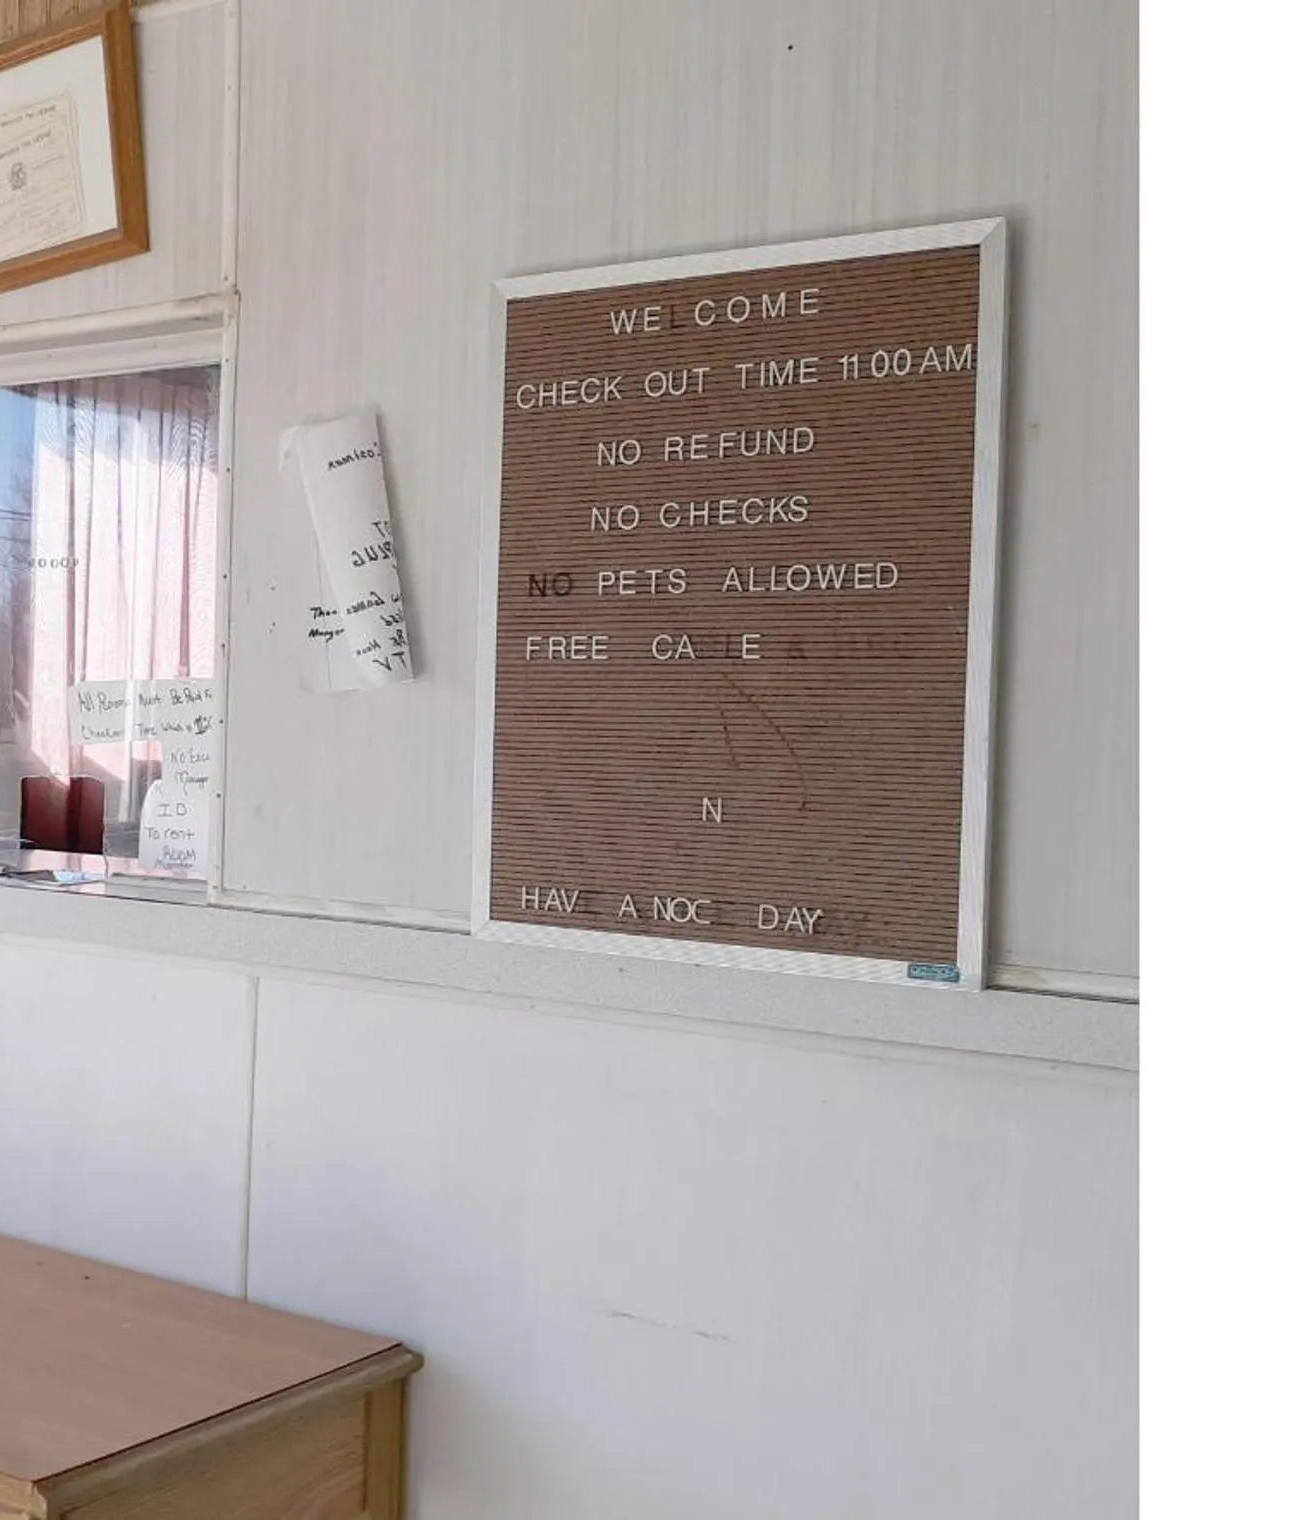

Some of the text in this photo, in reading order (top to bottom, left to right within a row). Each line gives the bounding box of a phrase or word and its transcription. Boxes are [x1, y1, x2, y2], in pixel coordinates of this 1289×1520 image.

[515, 375, 623, 410] CHECK
[644, 367, 710, 398] OUT
[735, 357, 819, 390] TIME
[919, 343, 973, 375] AM
[597, 426, 815, 467] NO REFUND
[590, 496, 809, 532] NO CHECKS
[598, 568, 688, 596] PETS
[722, 561, 899, 594] ALLOWED
[526, 635, 609, 661] FREE
[701, 797, 723, 823] N
[521, 886, 580, 913] HAV
[618, 894, 638, 919] A
[758, 903, 824, 935] DAY
